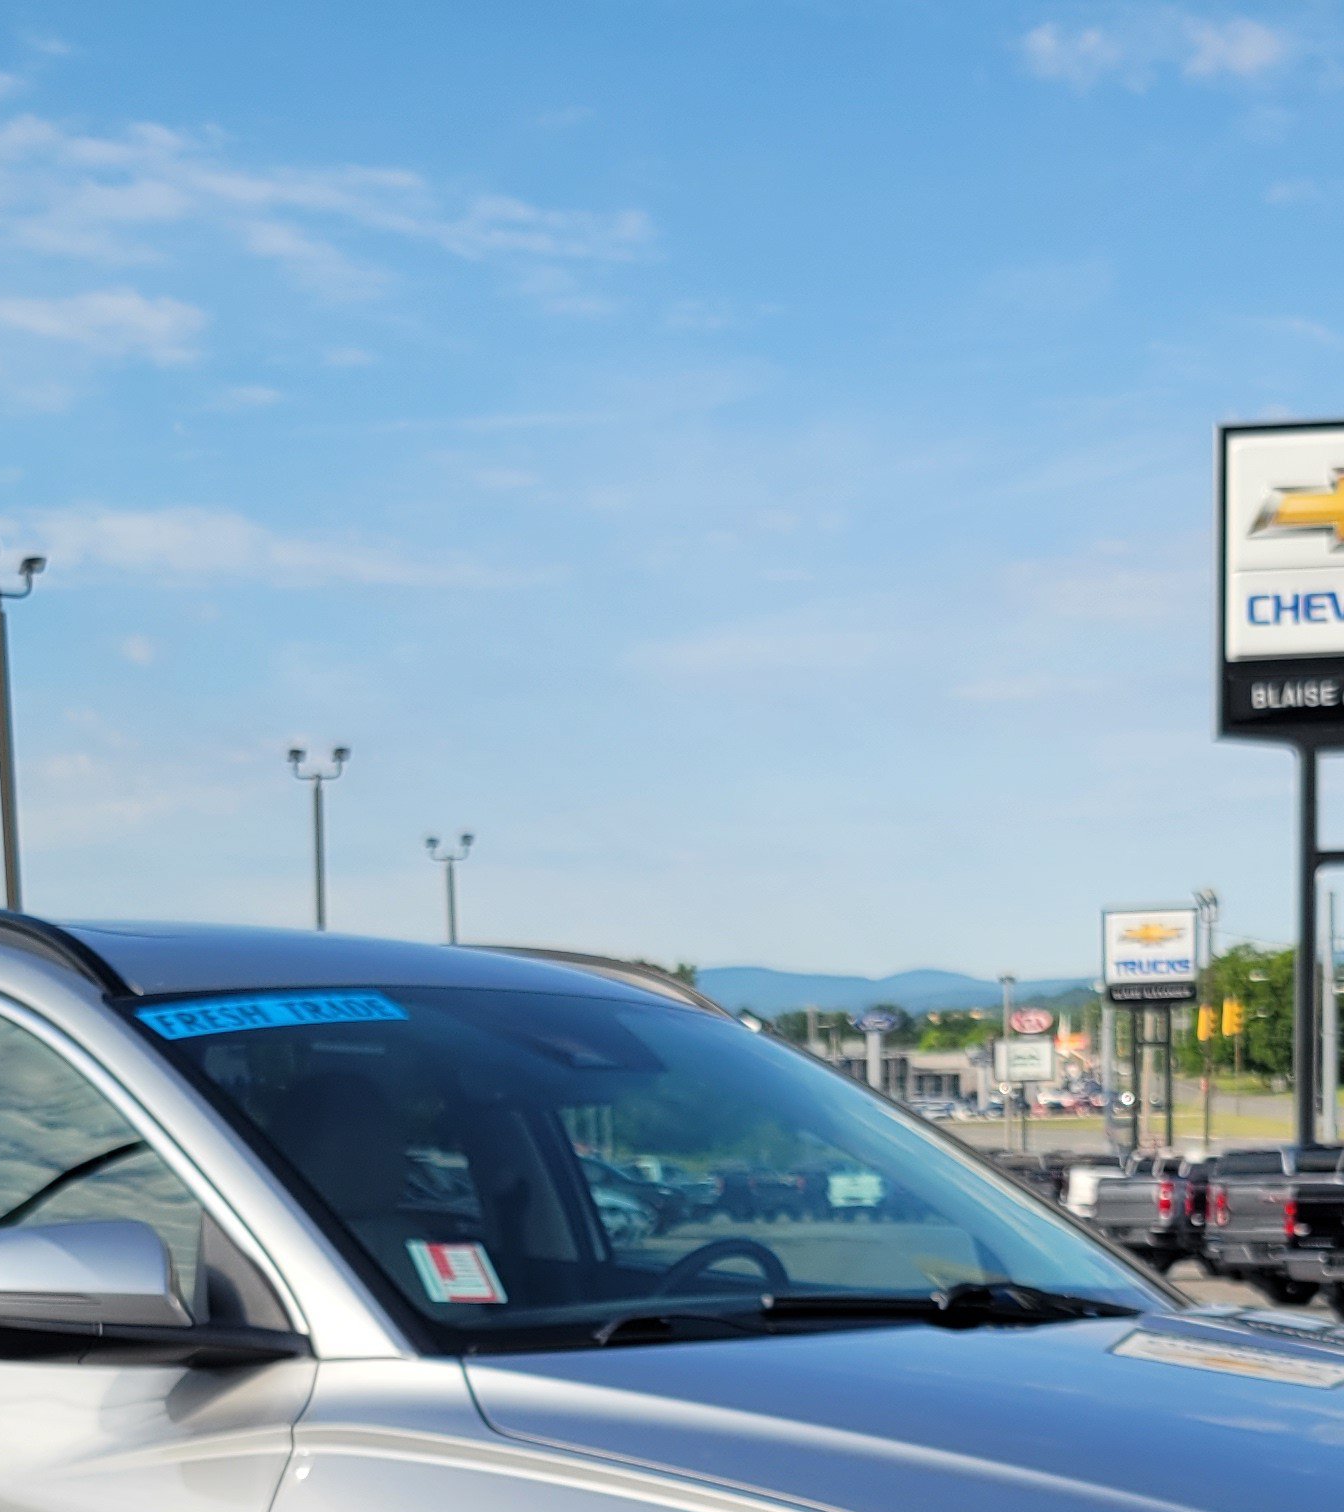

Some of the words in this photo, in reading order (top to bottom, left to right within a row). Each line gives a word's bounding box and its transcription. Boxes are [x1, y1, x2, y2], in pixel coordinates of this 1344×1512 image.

[1251, 679, 1339, 709] BLAISE
[1115, 959, 1191, 976] TRUCKS
[154, 1003, 273, 1036] FRESH
[281, 997, 389, 1022] TRADE
